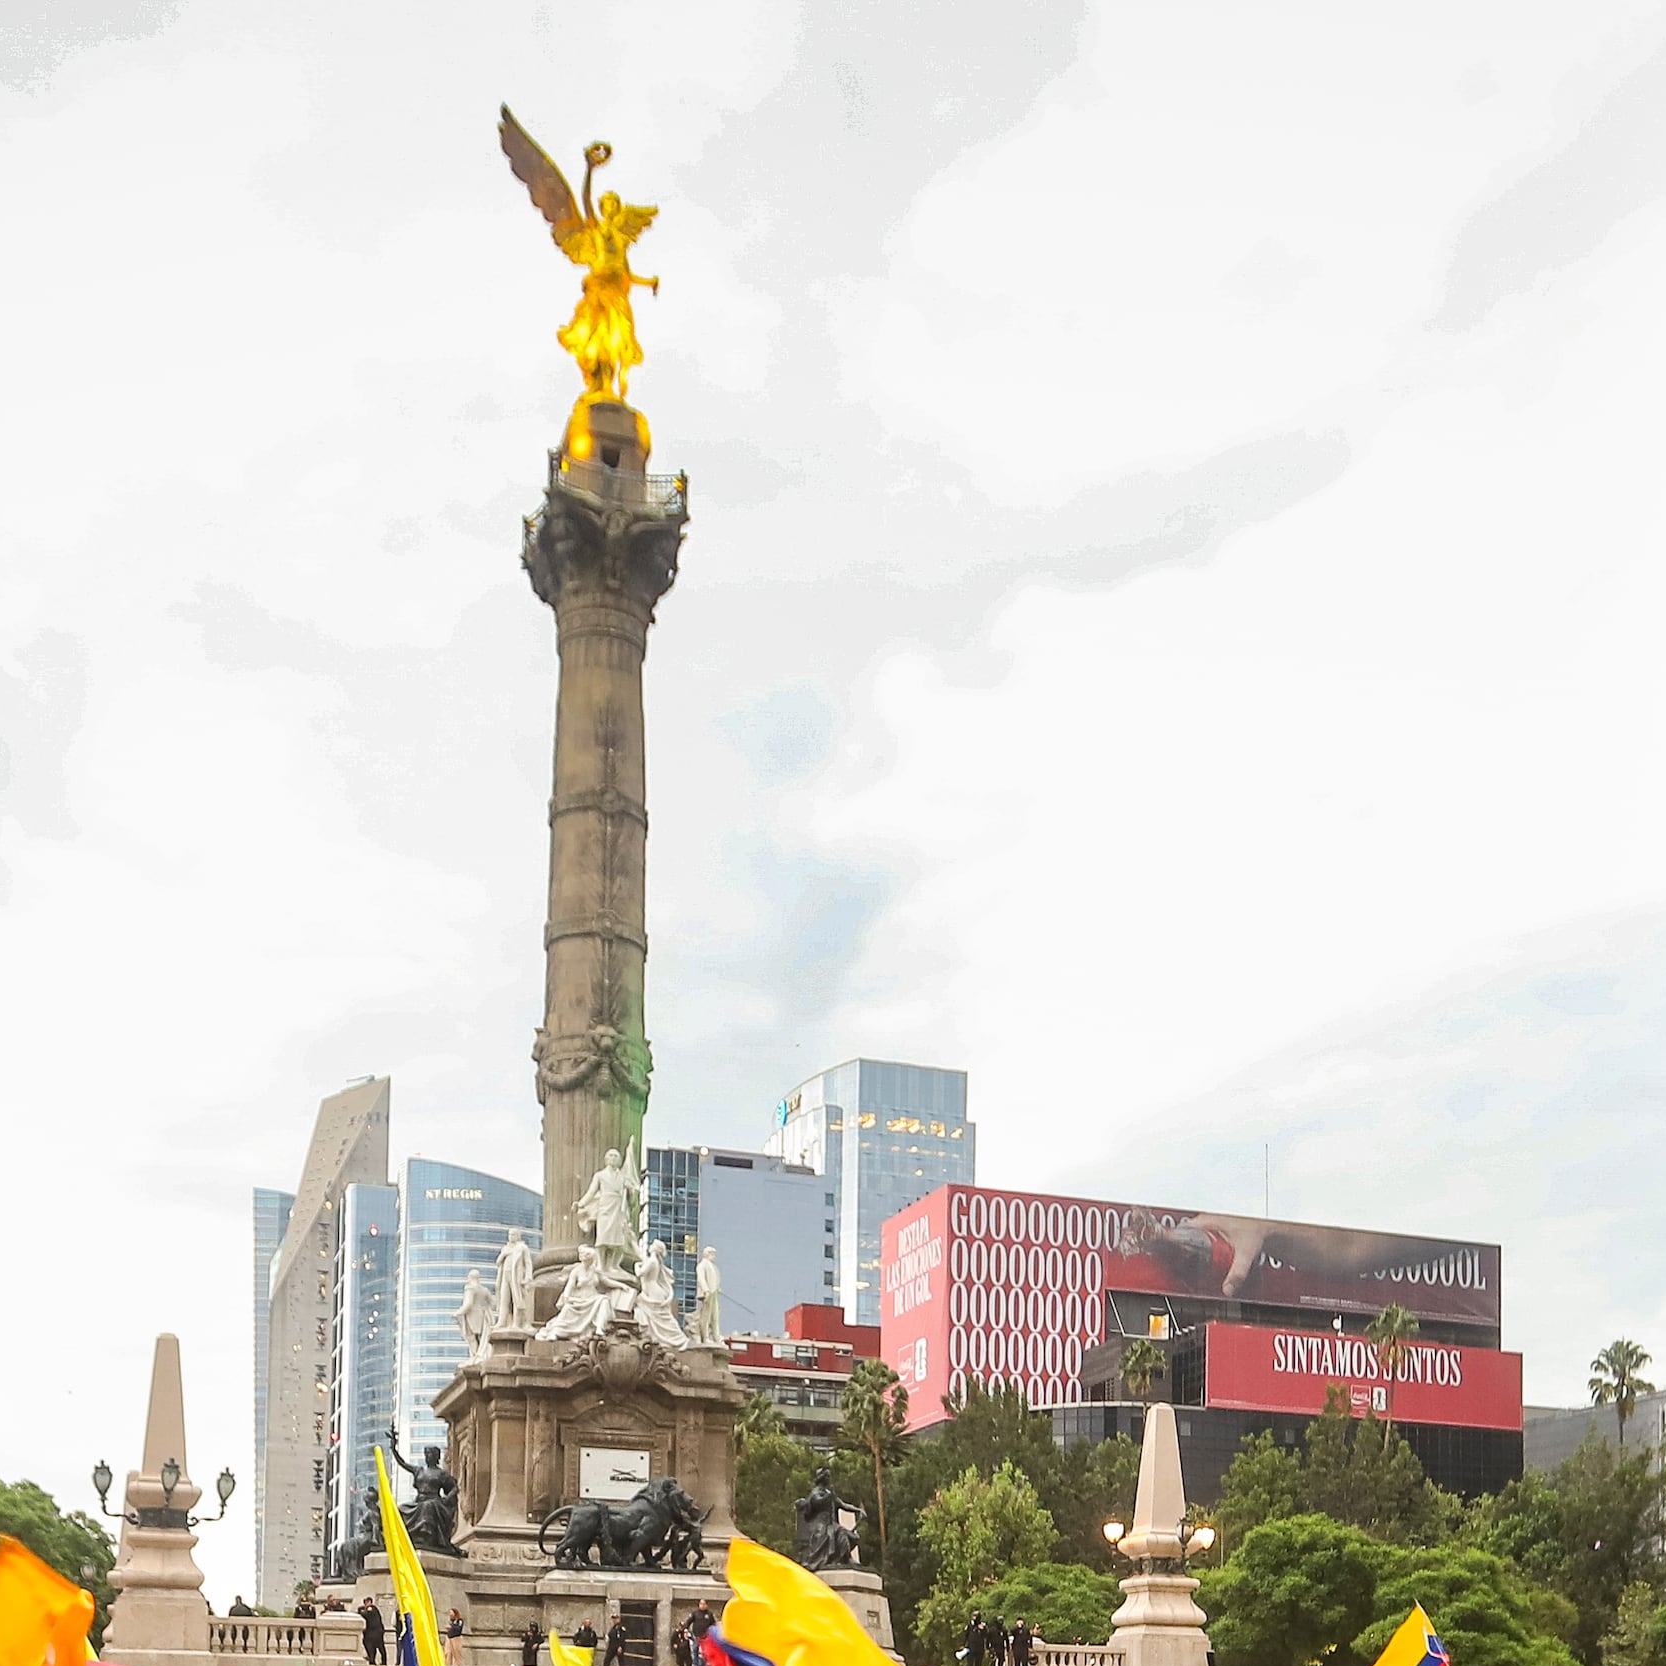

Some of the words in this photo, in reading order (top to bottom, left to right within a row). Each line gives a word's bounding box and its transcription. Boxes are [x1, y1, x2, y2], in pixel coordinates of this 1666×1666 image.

[443, 1188, 483, 1201] REGIS
[886, 1260, 901, 1294] LAS
[1273, 1334, 1378, 1381] SINTAMOS
[1382, 1345, 1462, 1388] JUNTOS
